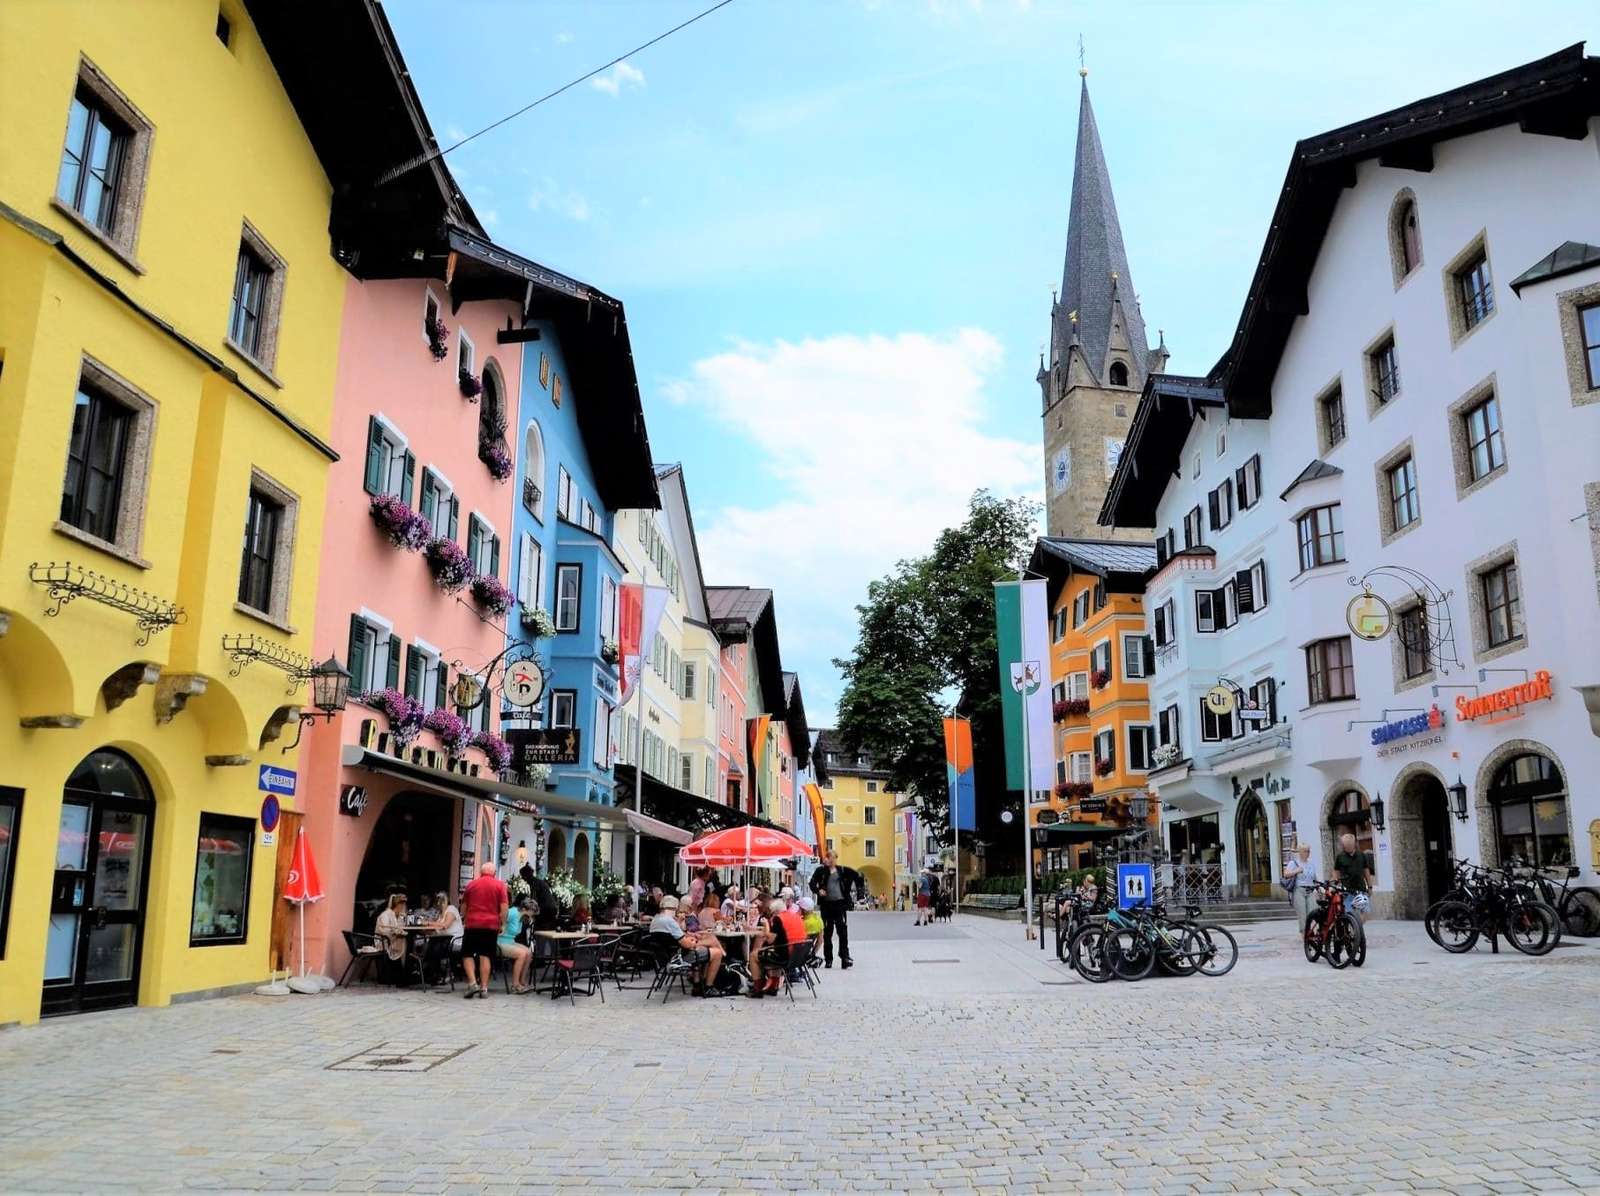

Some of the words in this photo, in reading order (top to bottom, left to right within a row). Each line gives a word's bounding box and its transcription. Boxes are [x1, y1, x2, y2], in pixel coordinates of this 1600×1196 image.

[1456, 669, 1552, 722] SONNENTOR
[1371, 711, 1430, 746] SPARKASSE
[268, 774, 293, 787] EINBAHN
